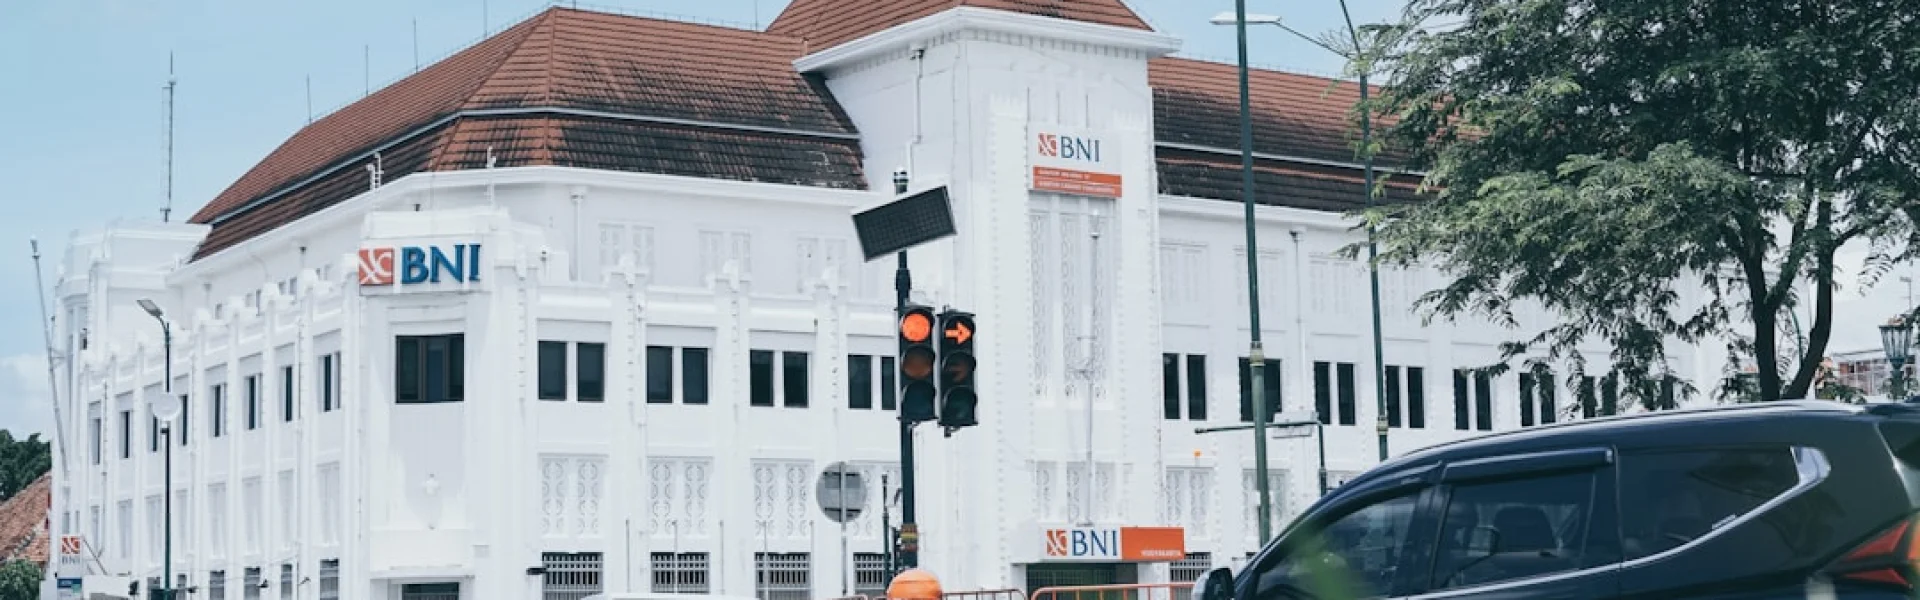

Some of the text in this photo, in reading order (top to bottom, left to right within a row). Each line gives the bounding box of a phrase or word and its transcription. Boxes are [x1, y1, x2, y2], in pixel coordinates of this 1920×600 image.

[1060, 135, 1100, 162] BNI
[401, 243, 482, 285] BNI
[1071, 530, 1118, 556] BNI
[61, 550, 81, 564] BNI
